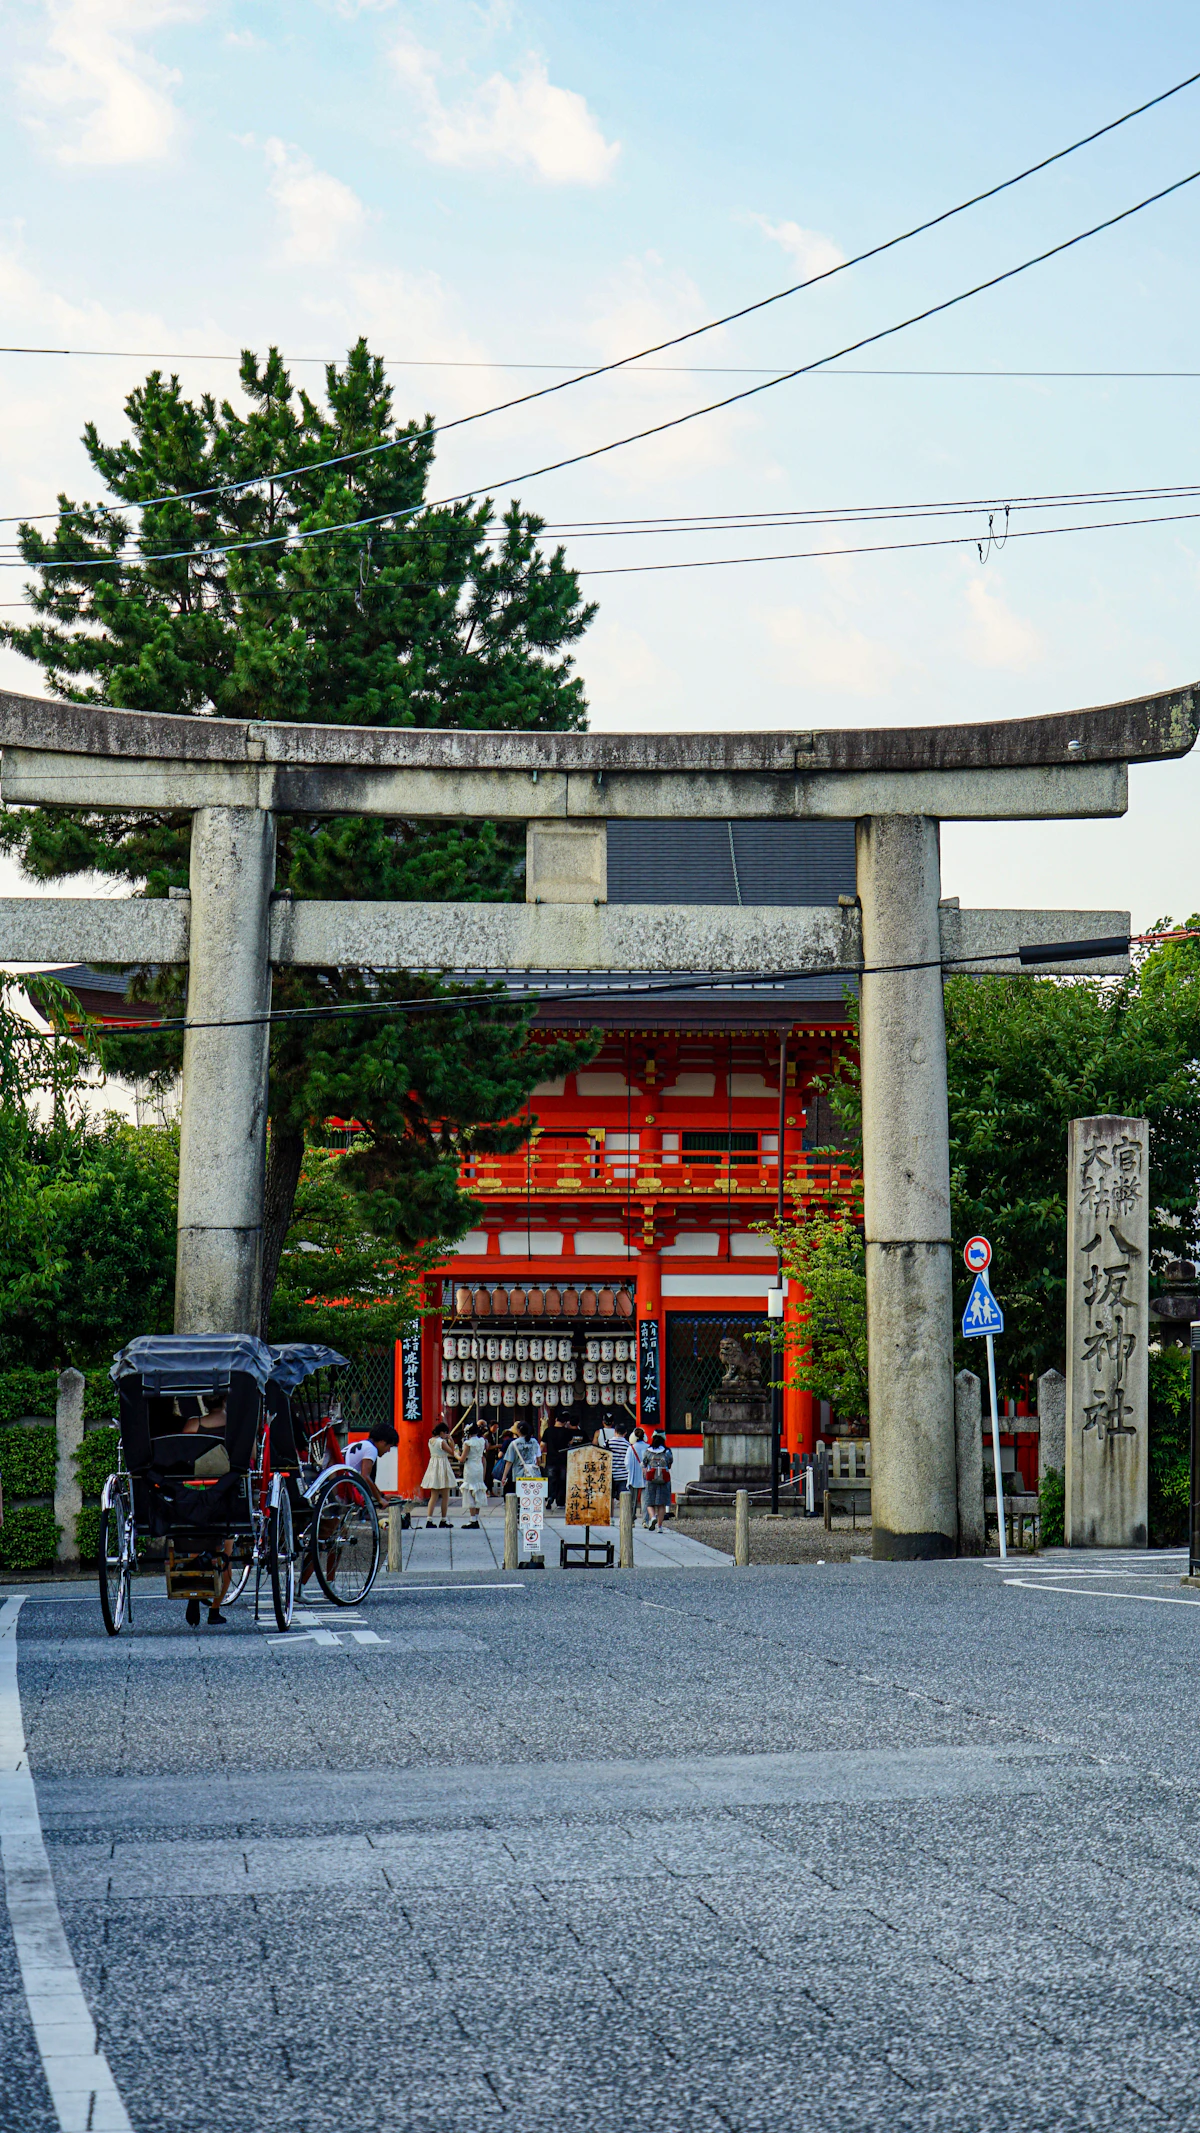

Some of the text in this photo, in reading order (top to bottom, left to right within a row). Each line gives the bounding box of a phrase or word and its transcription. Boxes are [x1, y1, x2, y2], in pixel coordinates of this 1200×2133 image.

[1080, 1135, 1112, 1215] 大社
[648, 1321, 658, 1348] 八月一日
[1080, 1224, 1142, 1440] 八坂神社
[642, 1350, 658, 1414] 月次祭
[581, 1461, 598, 1511] 駐車禁止
